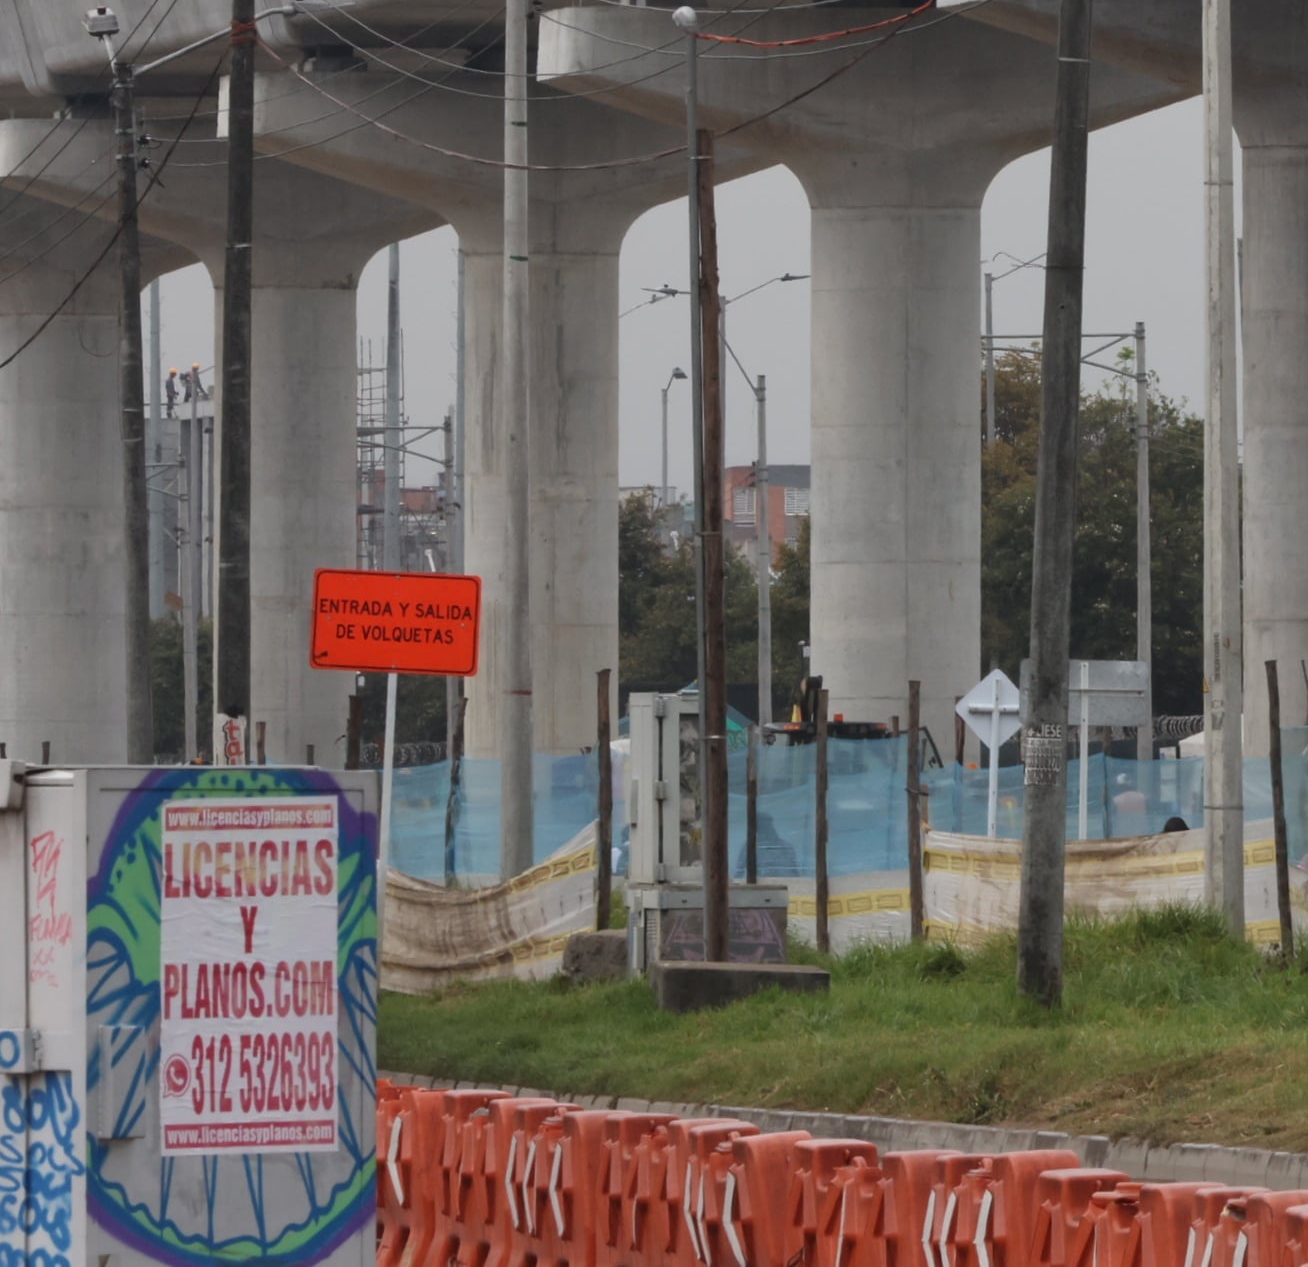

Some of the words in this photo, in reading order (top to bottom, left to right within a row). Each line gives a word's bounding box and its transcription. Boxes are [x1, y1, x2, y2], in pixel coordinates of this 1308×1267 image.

[319, 598, 393, 616] ENTRADA
[400, 603, 410, 617] Y
[415, 603, 472, 620] SALIDA
[336, 624, 355, 640] DE
[362, 625, 454, 644] VOLQUETAS
[168, 807, 332, 828] www.licenciasyplanos.com
[164, 839, 334, 899] LICENCIAS
[240, 906, 258, 953] Y
[164, 960, 333, 1019] PLANOS.COM
[191, 1033, 232, 1115] 312
[239, 1031, 334, 1113] 5326393
[167, 1123, 332, 1145] www.licenciasyplanos.com
